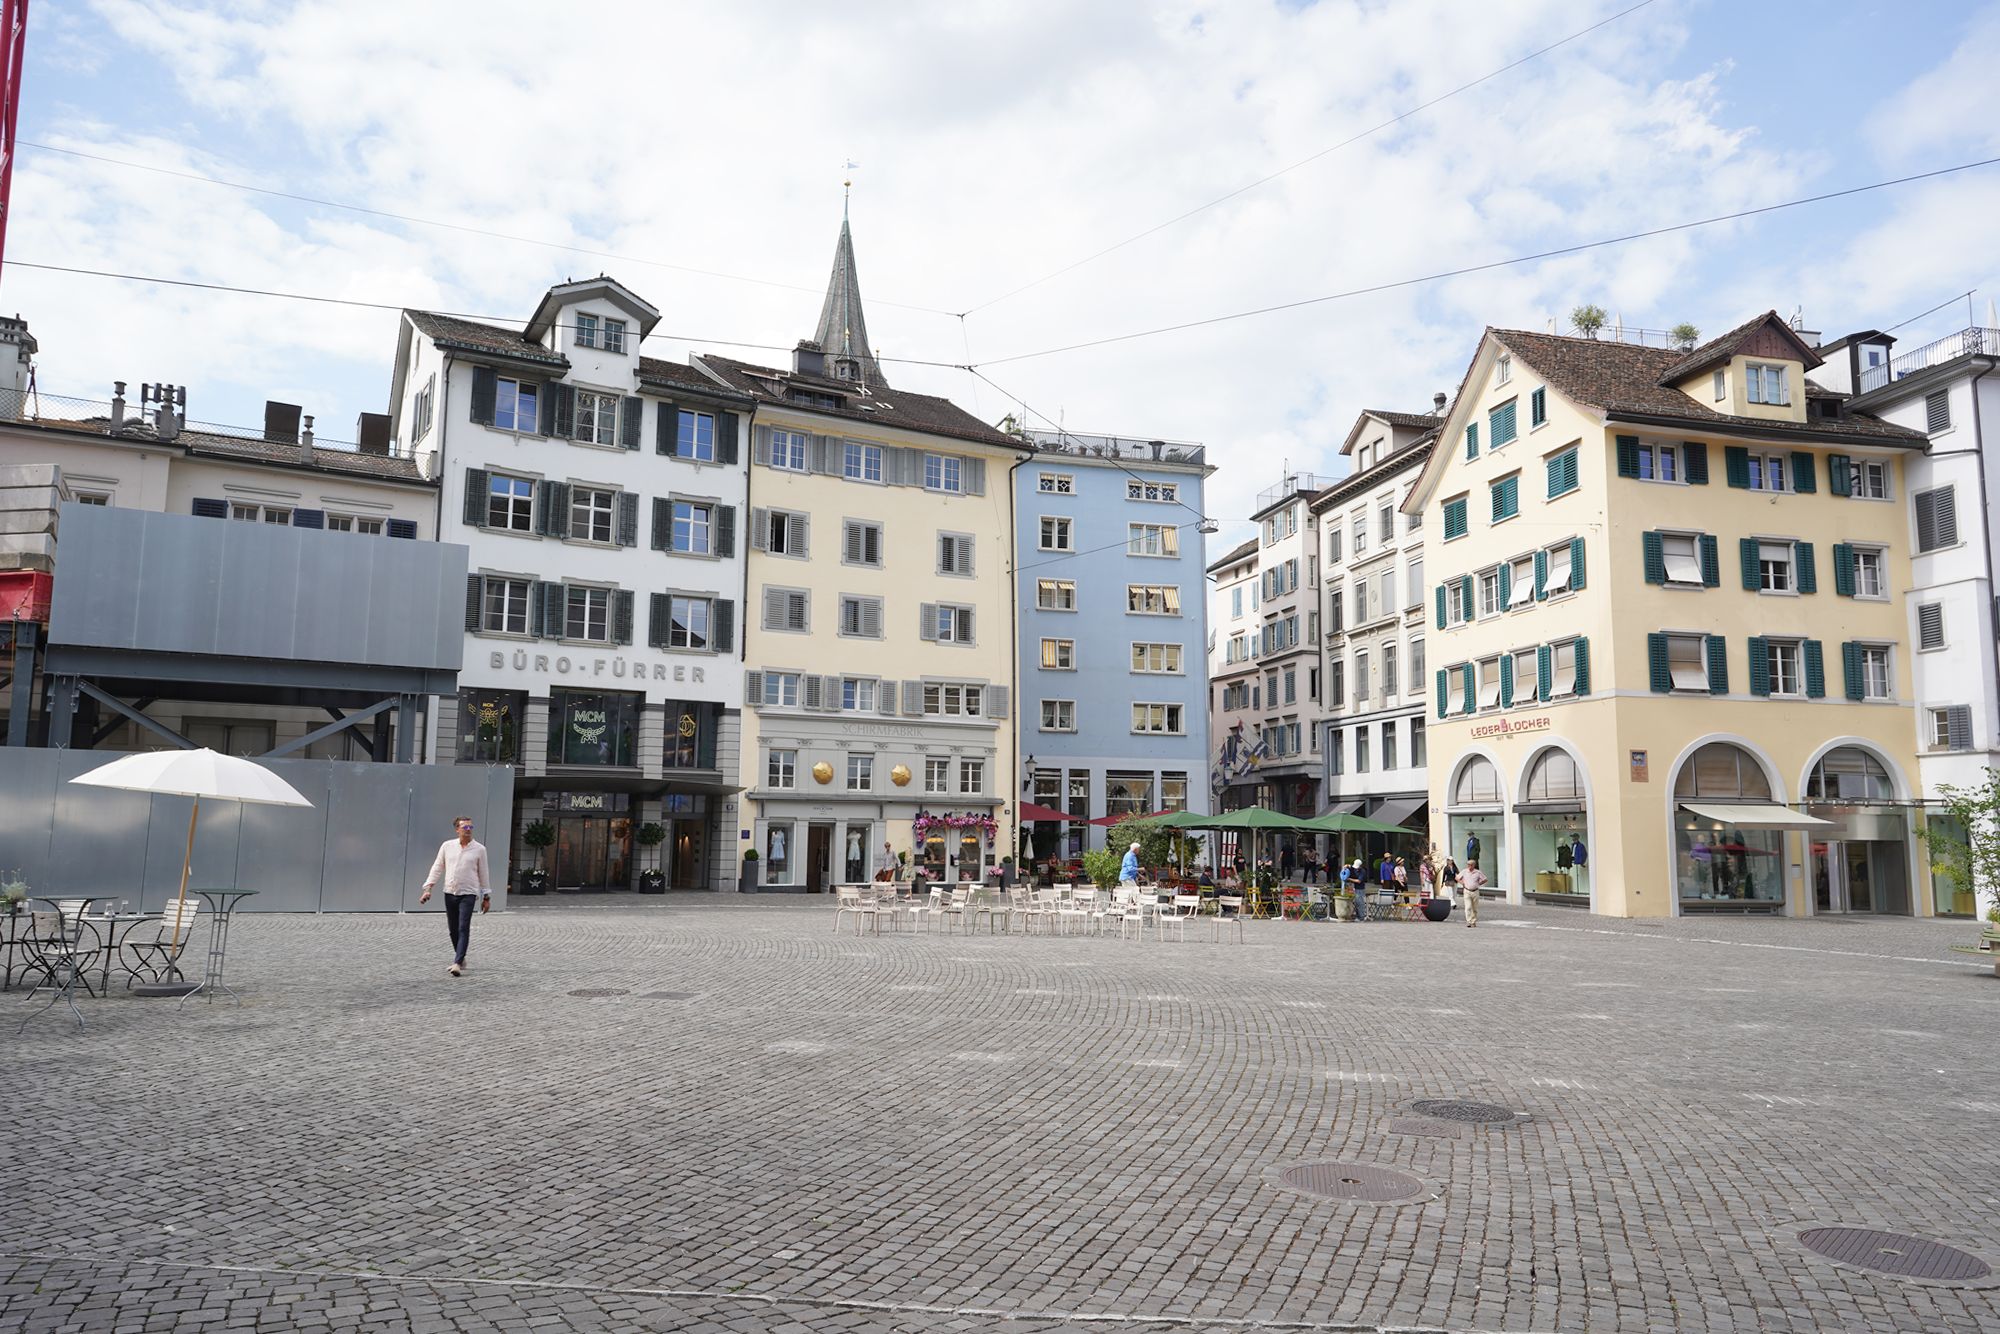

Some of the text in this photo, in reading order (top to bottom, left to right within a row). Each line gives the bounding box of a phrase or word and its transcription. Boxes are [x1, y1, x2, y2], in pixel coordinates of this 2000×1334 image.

[574, 710, 606, 722] MCM
[841, 722, 925, 737] SCHIRMFABRIK
[1471, 717, 1551, 736] LEDER LOCHER
[571, 795, 603, 808] MCM
